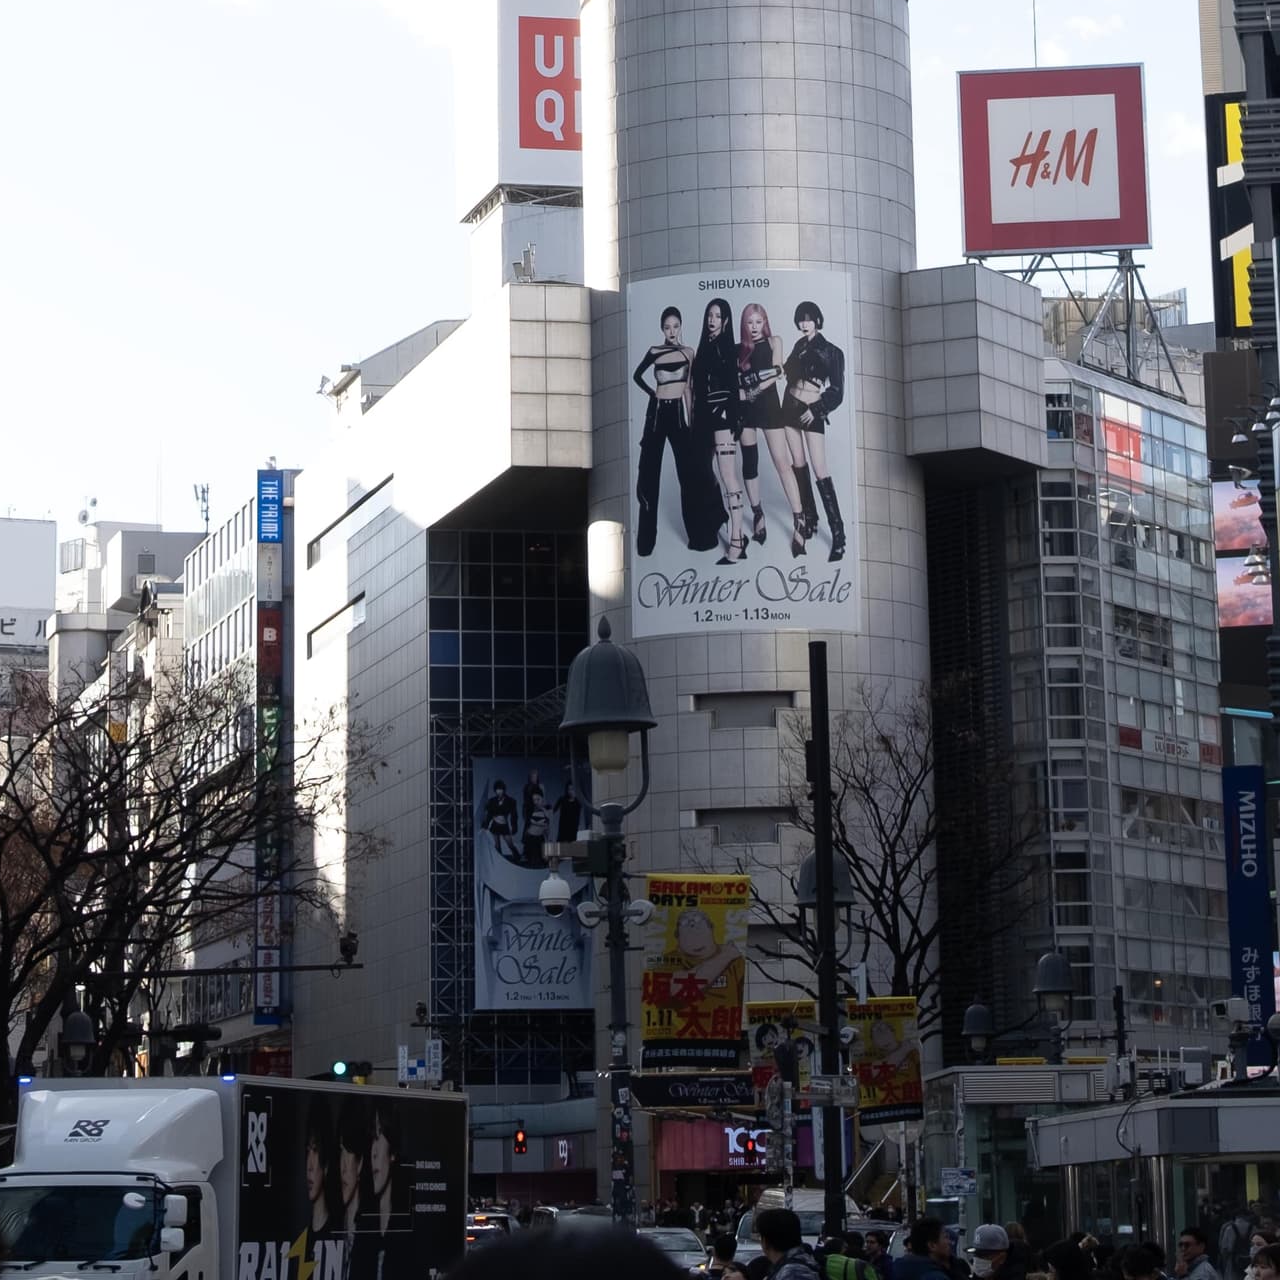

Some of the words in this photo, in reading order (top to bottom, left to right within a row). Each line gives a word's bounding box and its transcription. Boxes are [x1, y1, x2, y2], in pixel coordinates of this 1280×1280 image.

[1009, 127, 1098, 188] H&M
[698, 278, 771, 291] SHIBUYA109
[261, 479, 279, 503] THE
[260, 505, 279, 540] PRIME
[637, 568, 750, 610] Winter
[755, 565, 853, 606] Sale
[1237, 790, 1258, 878] MIZUHO
[649, 880, 747, 895] SAKAMOTO
[649, 894, 698, 907] DAYS
[496, 954, 577, 985] Sale
